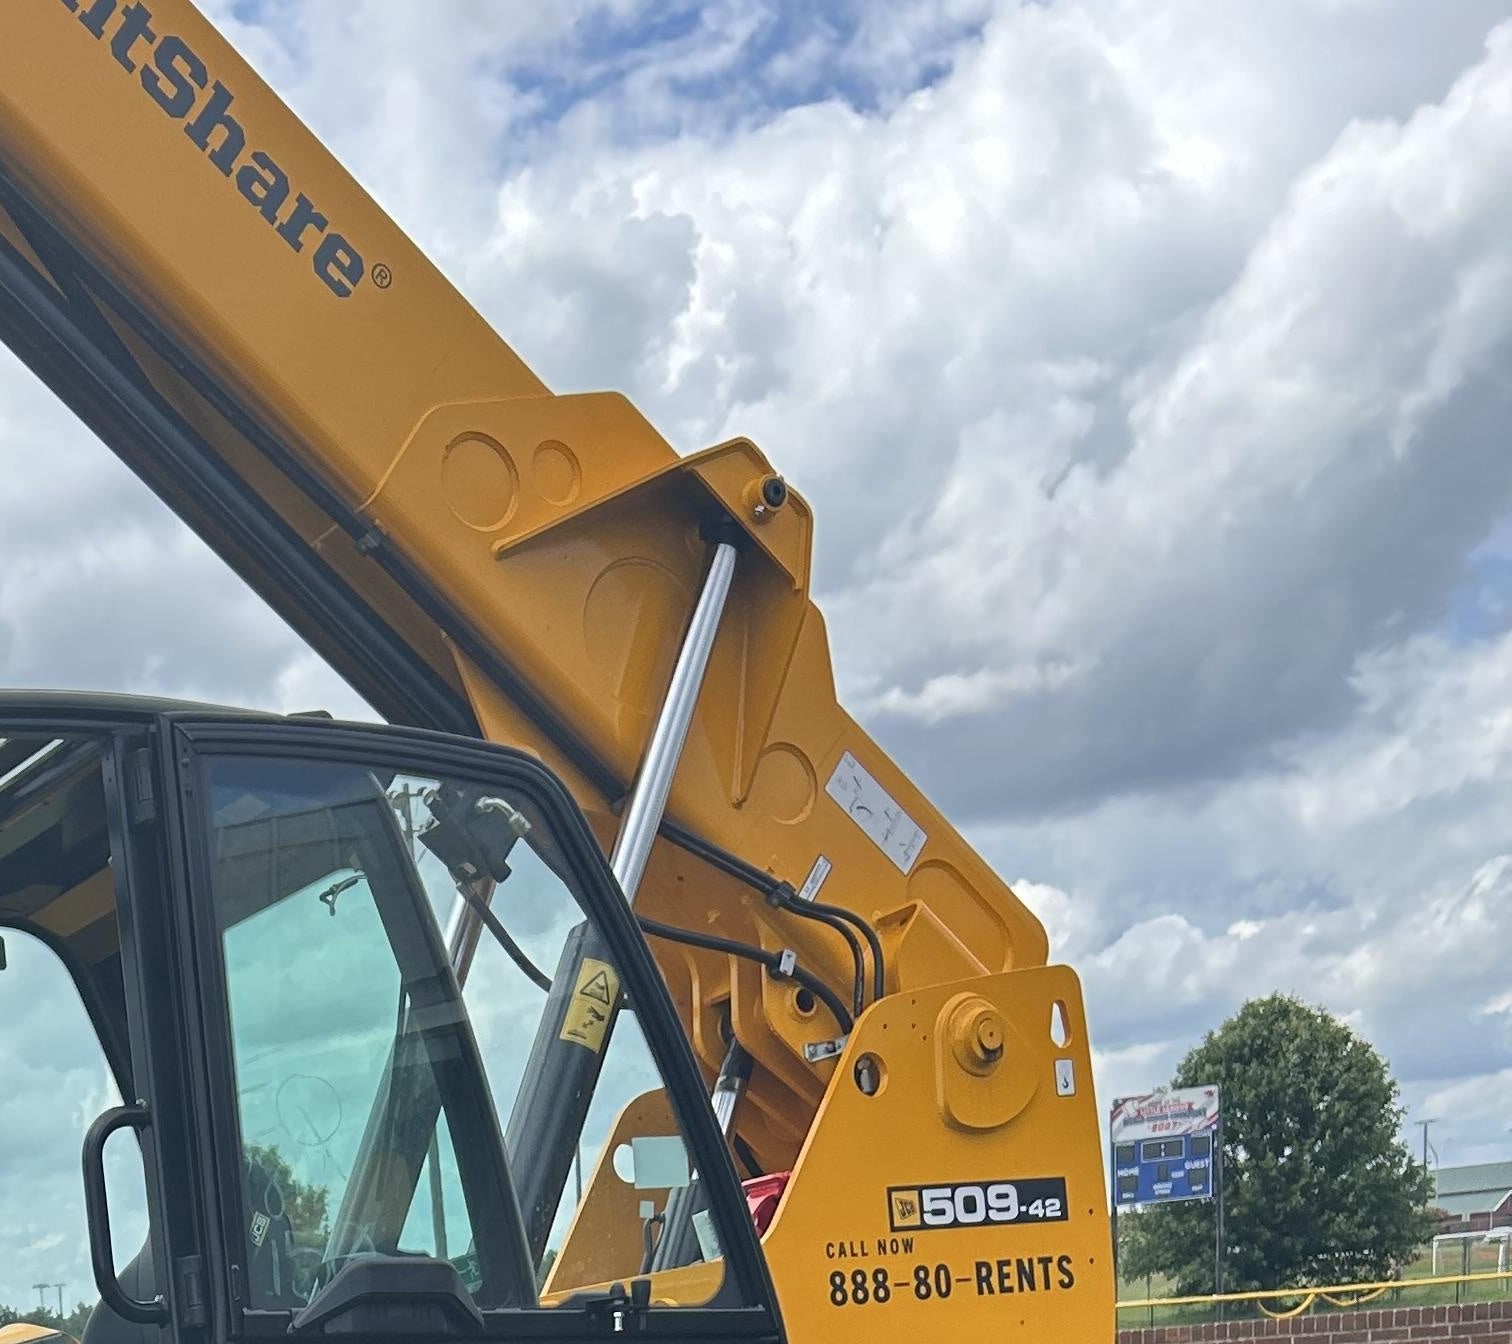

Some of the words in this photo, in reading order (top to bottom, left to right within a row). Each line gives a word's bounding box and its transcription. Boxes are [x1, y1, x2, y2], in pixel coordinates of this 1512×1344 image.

[922, 1184, 1062, 1225] 509-42
[826, 1242, 869, 1259] CALL
[877, 1238, 915, 1254] NOW
[829, 1255, 1075, 1306] 888-80-RENTS
